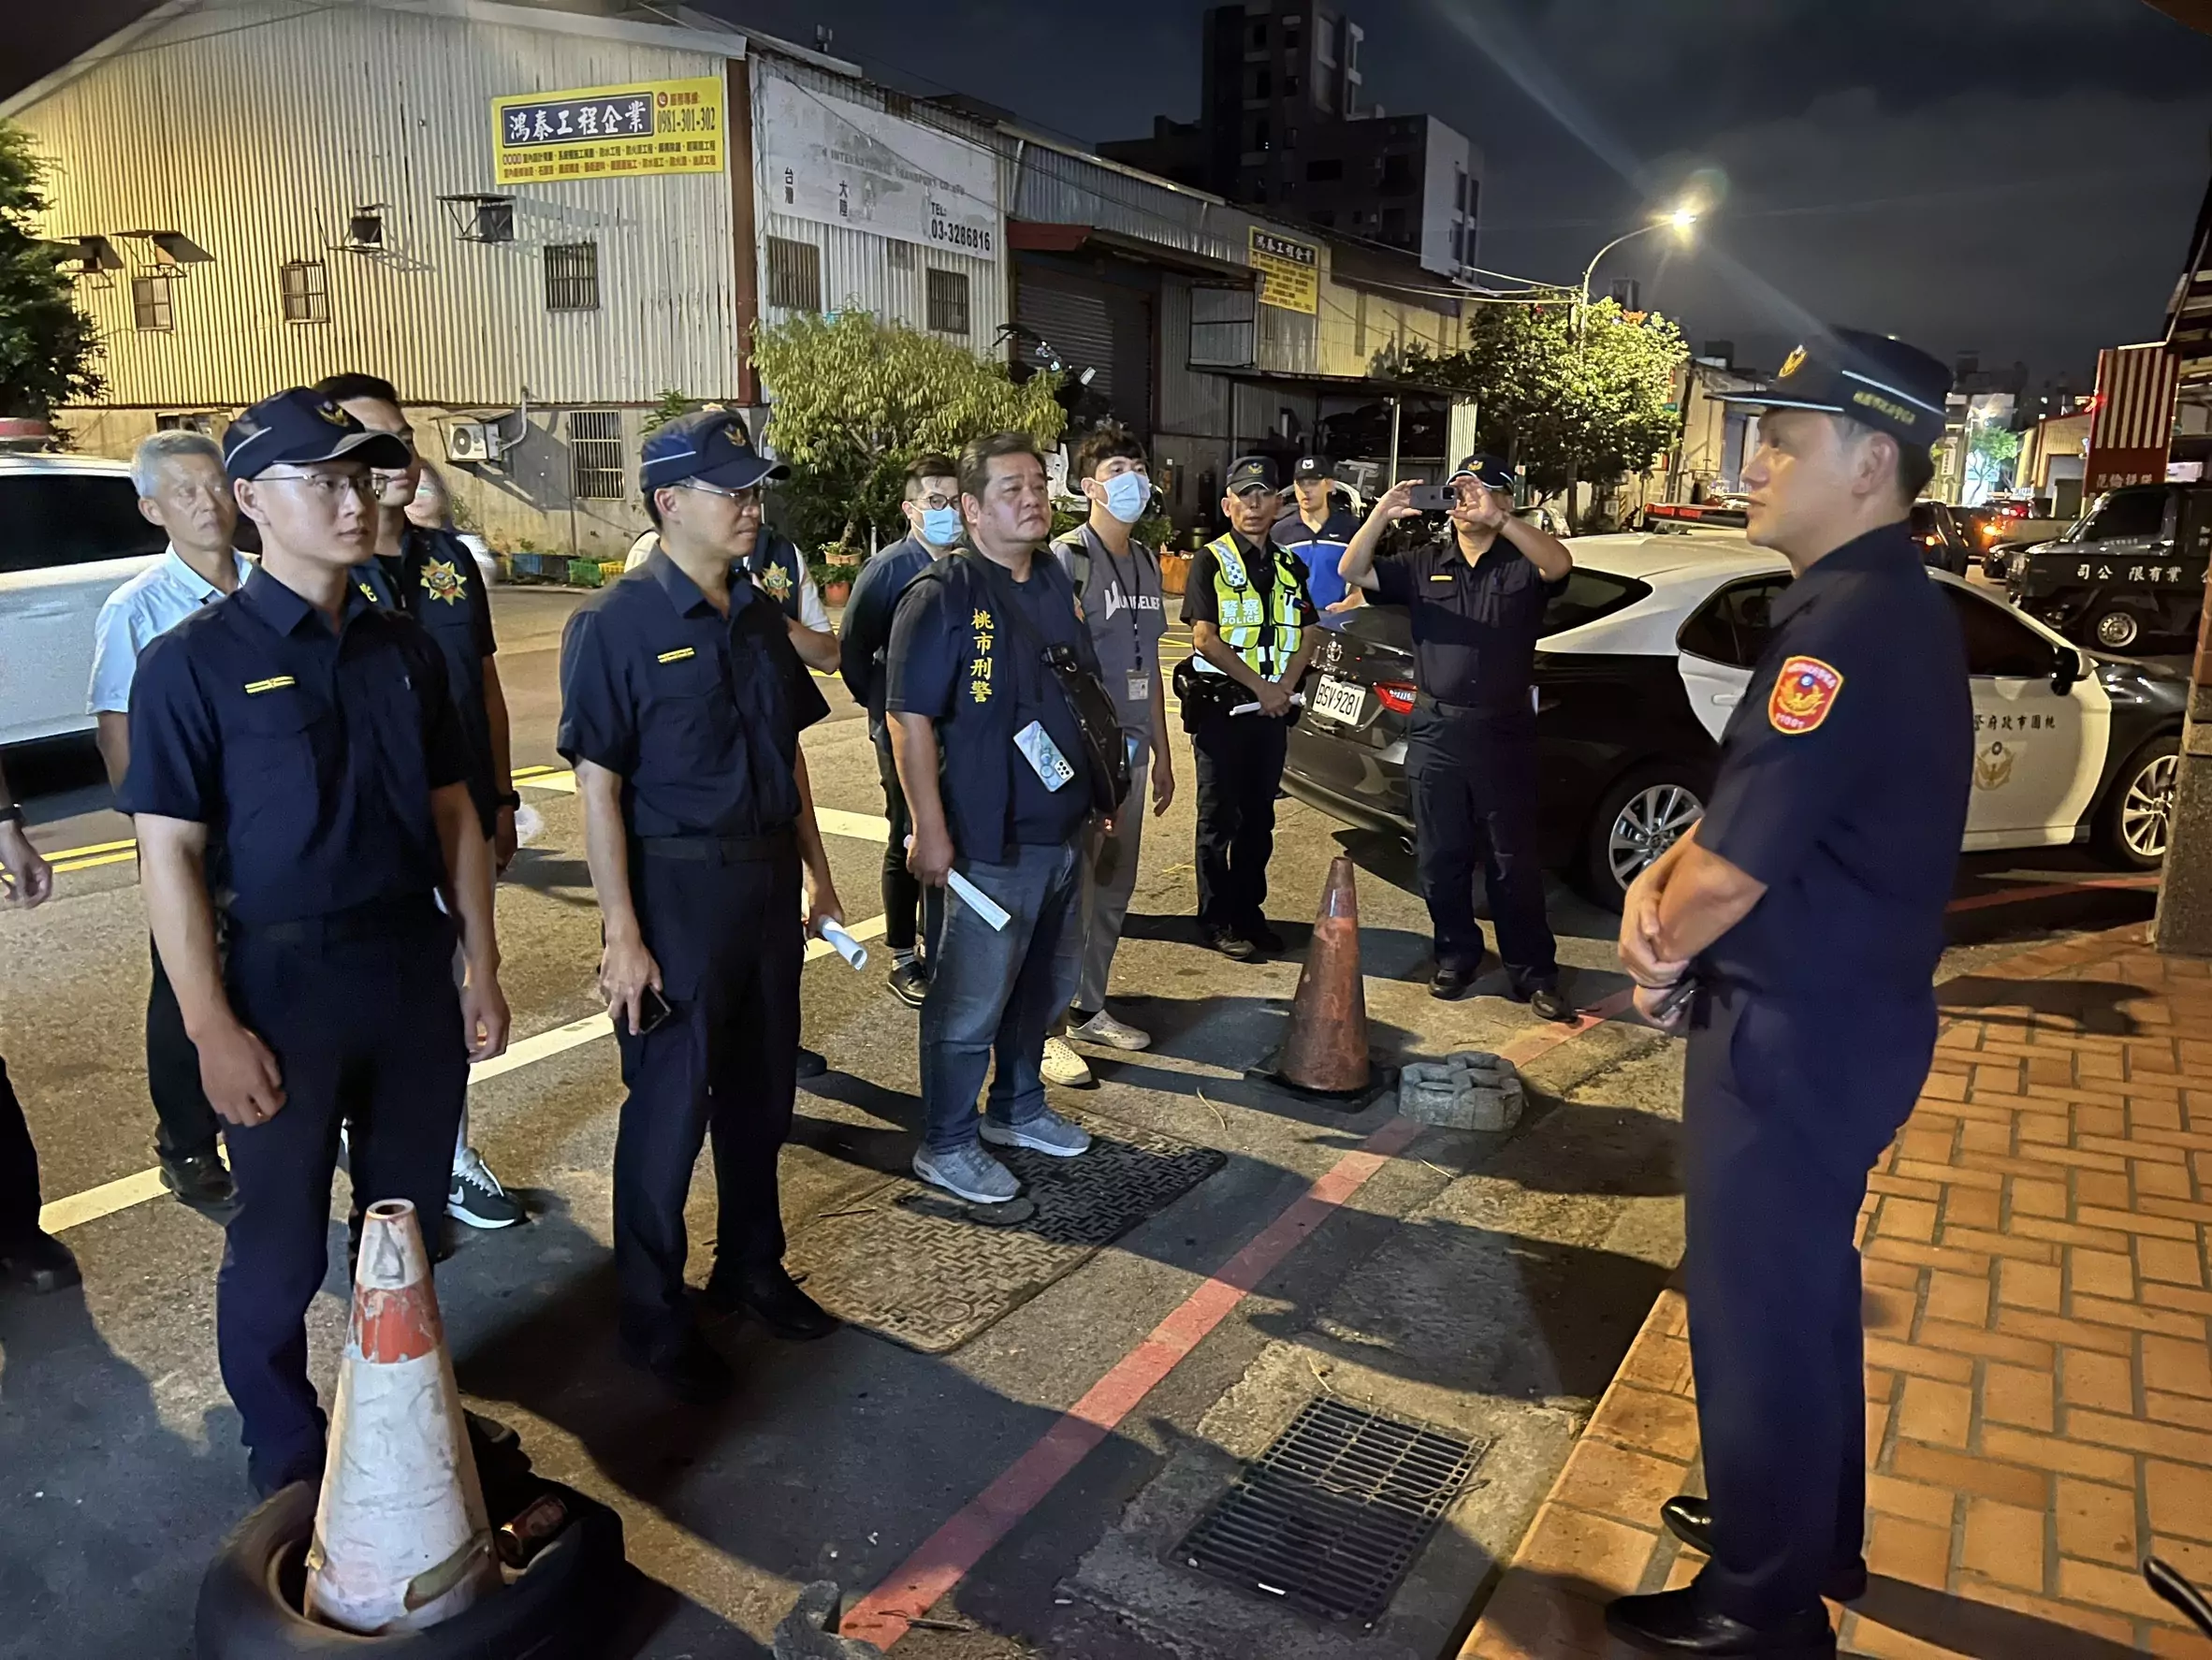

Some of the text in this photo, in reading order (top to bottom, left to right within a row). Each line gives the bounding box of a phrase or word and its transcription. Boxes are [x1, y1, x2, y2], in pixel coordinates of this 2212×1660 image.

[508, 100, 648, 142] 鴻泰工程企業
[657, 107, 716, 134] 0981-301-302
[931, 201, 947, 217] TEL:
[931, 218, 991, 252] 03-3286816
[1221, 599, 1259, 618] 警察
[1221, 616, 1260, 625] POLICE
[969, 607, 995, 704] 桃市刑警
[1316, 684, 1361, 718] BSV-9281
